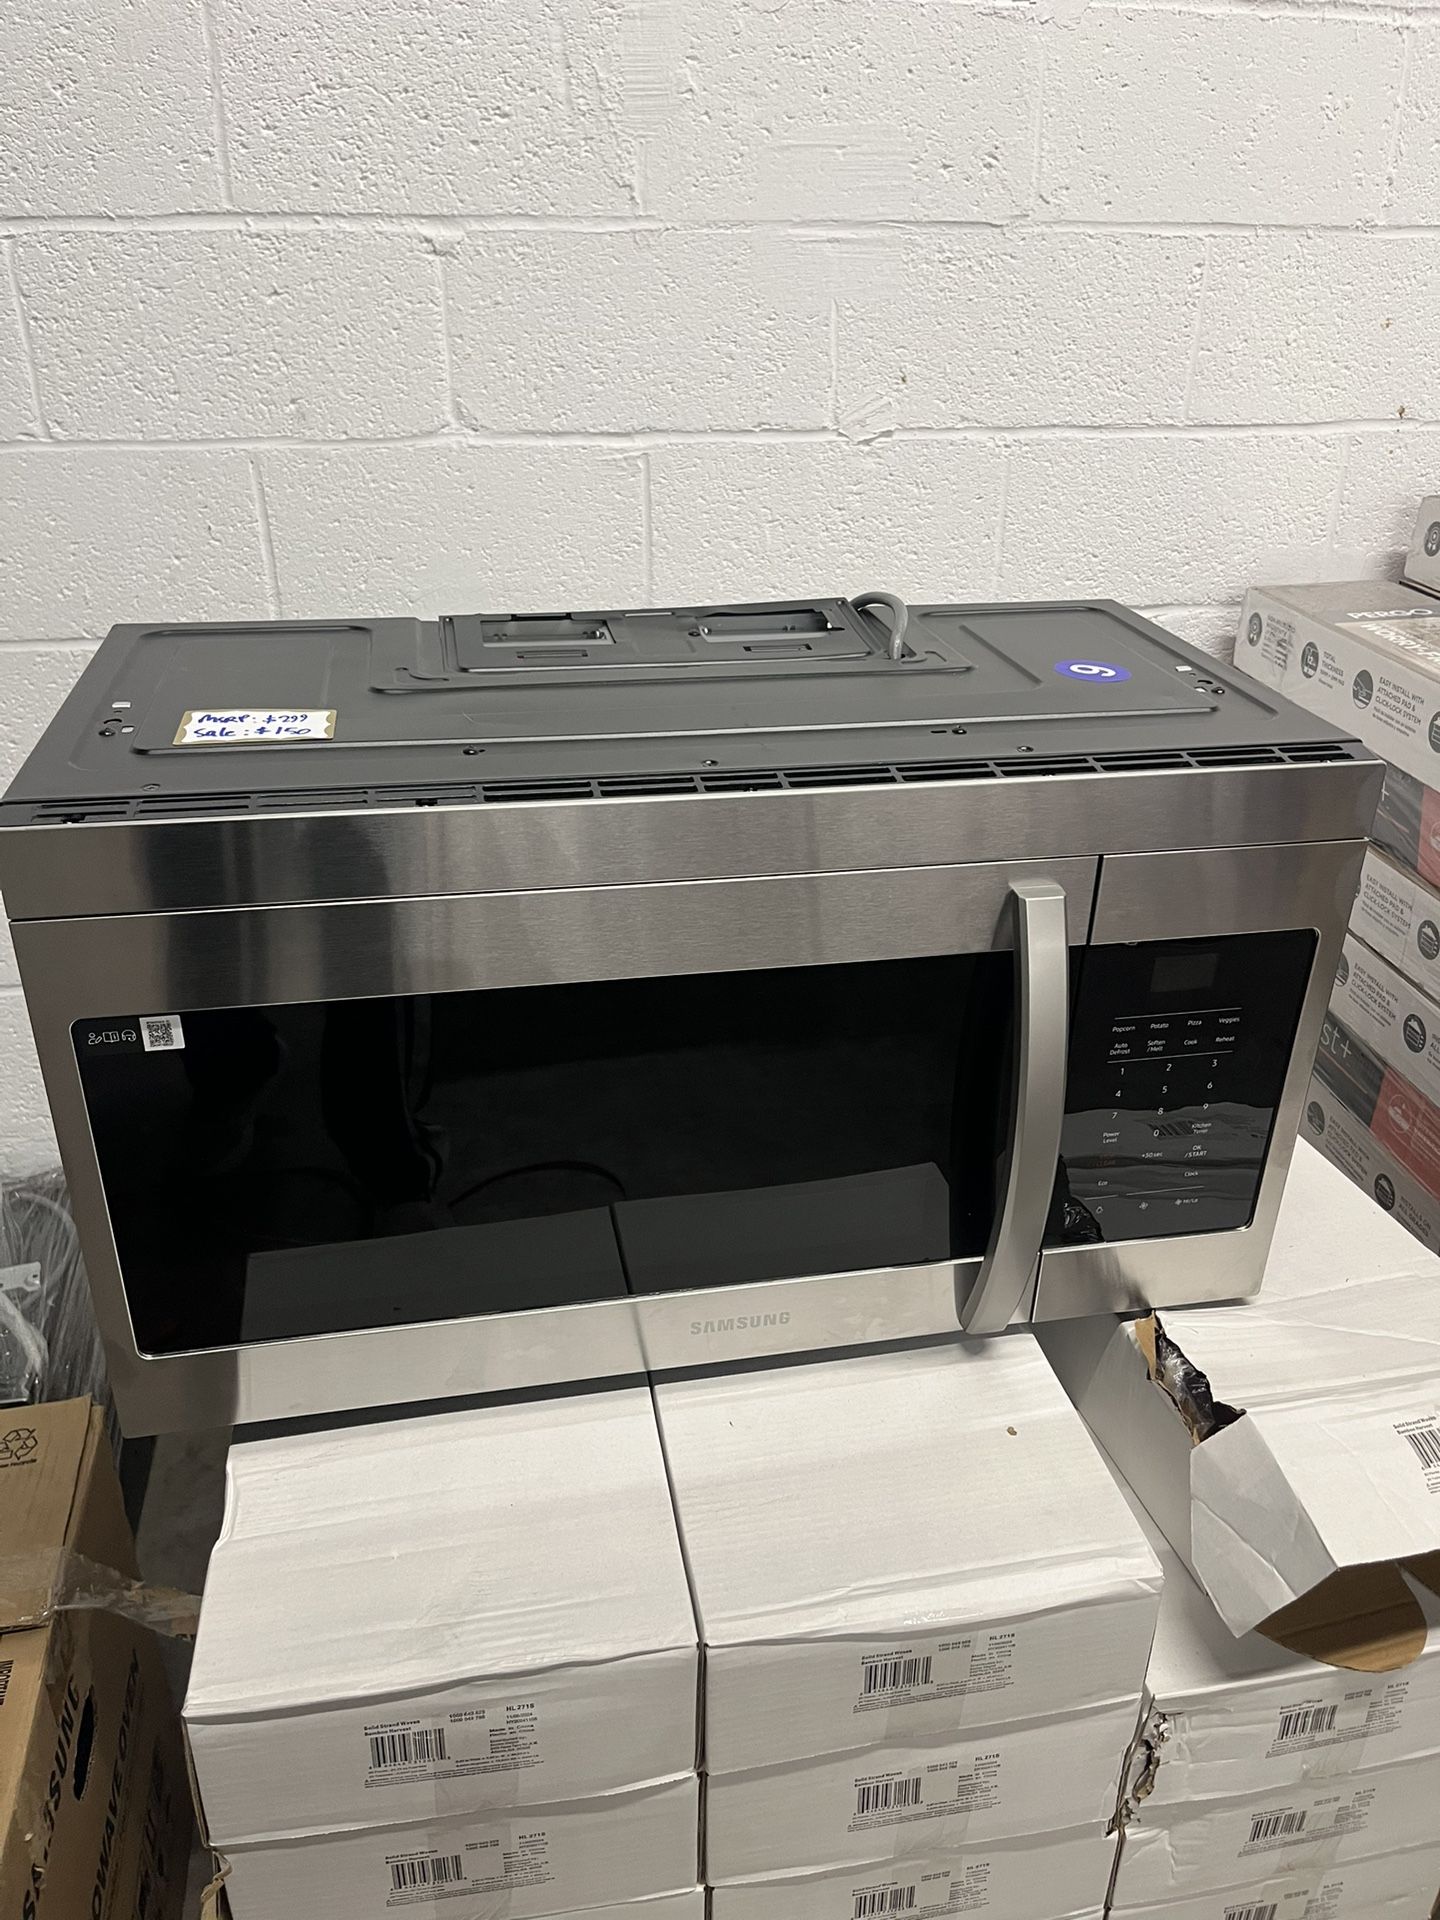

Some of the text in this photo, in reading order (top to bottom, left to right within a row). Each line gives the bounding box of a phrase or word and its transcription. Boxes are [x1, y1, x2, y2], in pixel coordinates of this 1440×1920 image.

[1218, 1016, 1241, 1024] Veggies
[1112, 1025, 1136, 1033] Popcorn
[1109, 1048, 1131, 1056] Defrost
[1212, 1059, 1218, 1067] 3
[1120, 1067, 1125, 1076] 1
[1166, 1064, 1172, 1072] 2
[1207, 1081, 1213, 1090] 6
[1115, 1090, 1121, 1098] 4
[1161, 1086, 1168, 1094] 5
[1157, 1107, 1164, 1115] 8
[1202, 1103, 1209, 1111] 9
[1112, 1112, 1118, 1120] 7
[1153, 1129, 1160, 1137] 0
[690, 1312, 791, 1335] SAMSUNG
